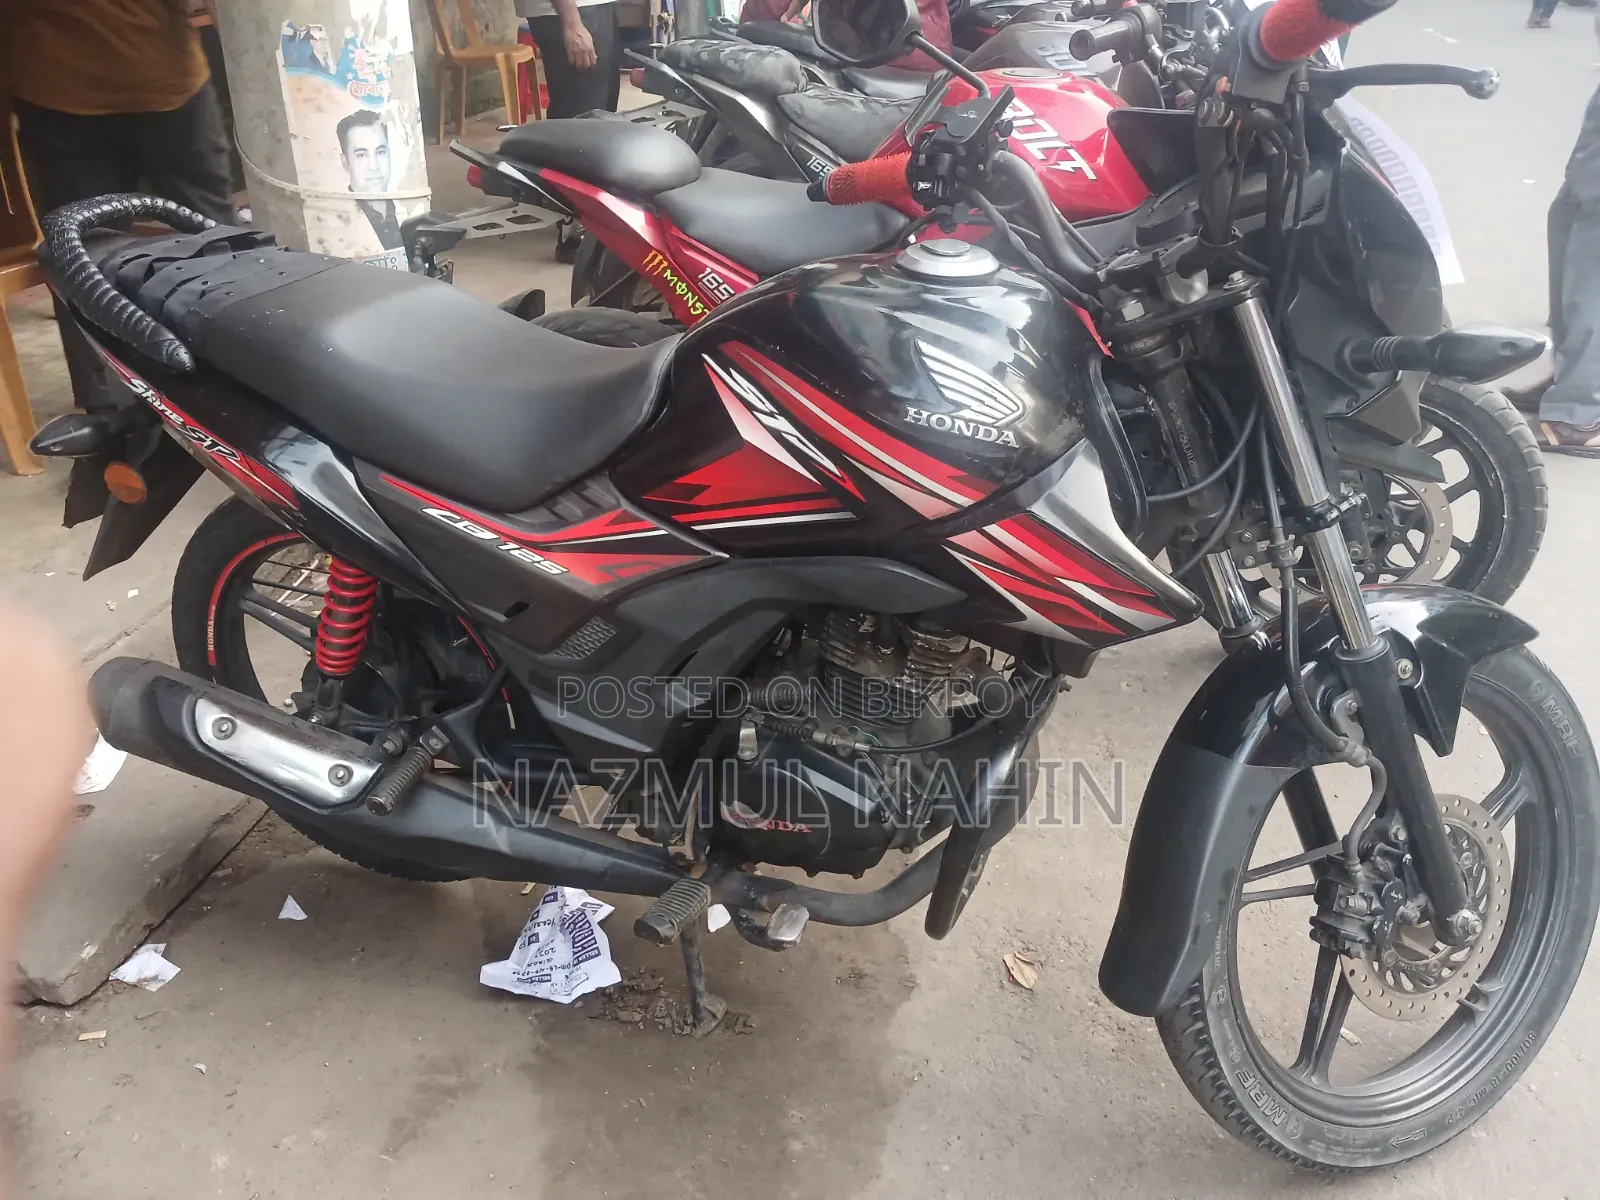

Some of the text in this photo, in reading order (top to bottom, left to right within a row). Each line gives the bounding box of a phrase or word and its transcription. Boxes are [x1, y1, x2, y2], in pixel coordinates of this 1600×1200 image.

[698, 267, 736, 301] 165
[126, 378, 185, 425] Shine
[904, 405, 1020, 449] HONDA
[421, 507, 570, 575] CB 125
[1540, 696, 1584, 757] MRF
[1235, 1069, 1288, 1127] MRF
